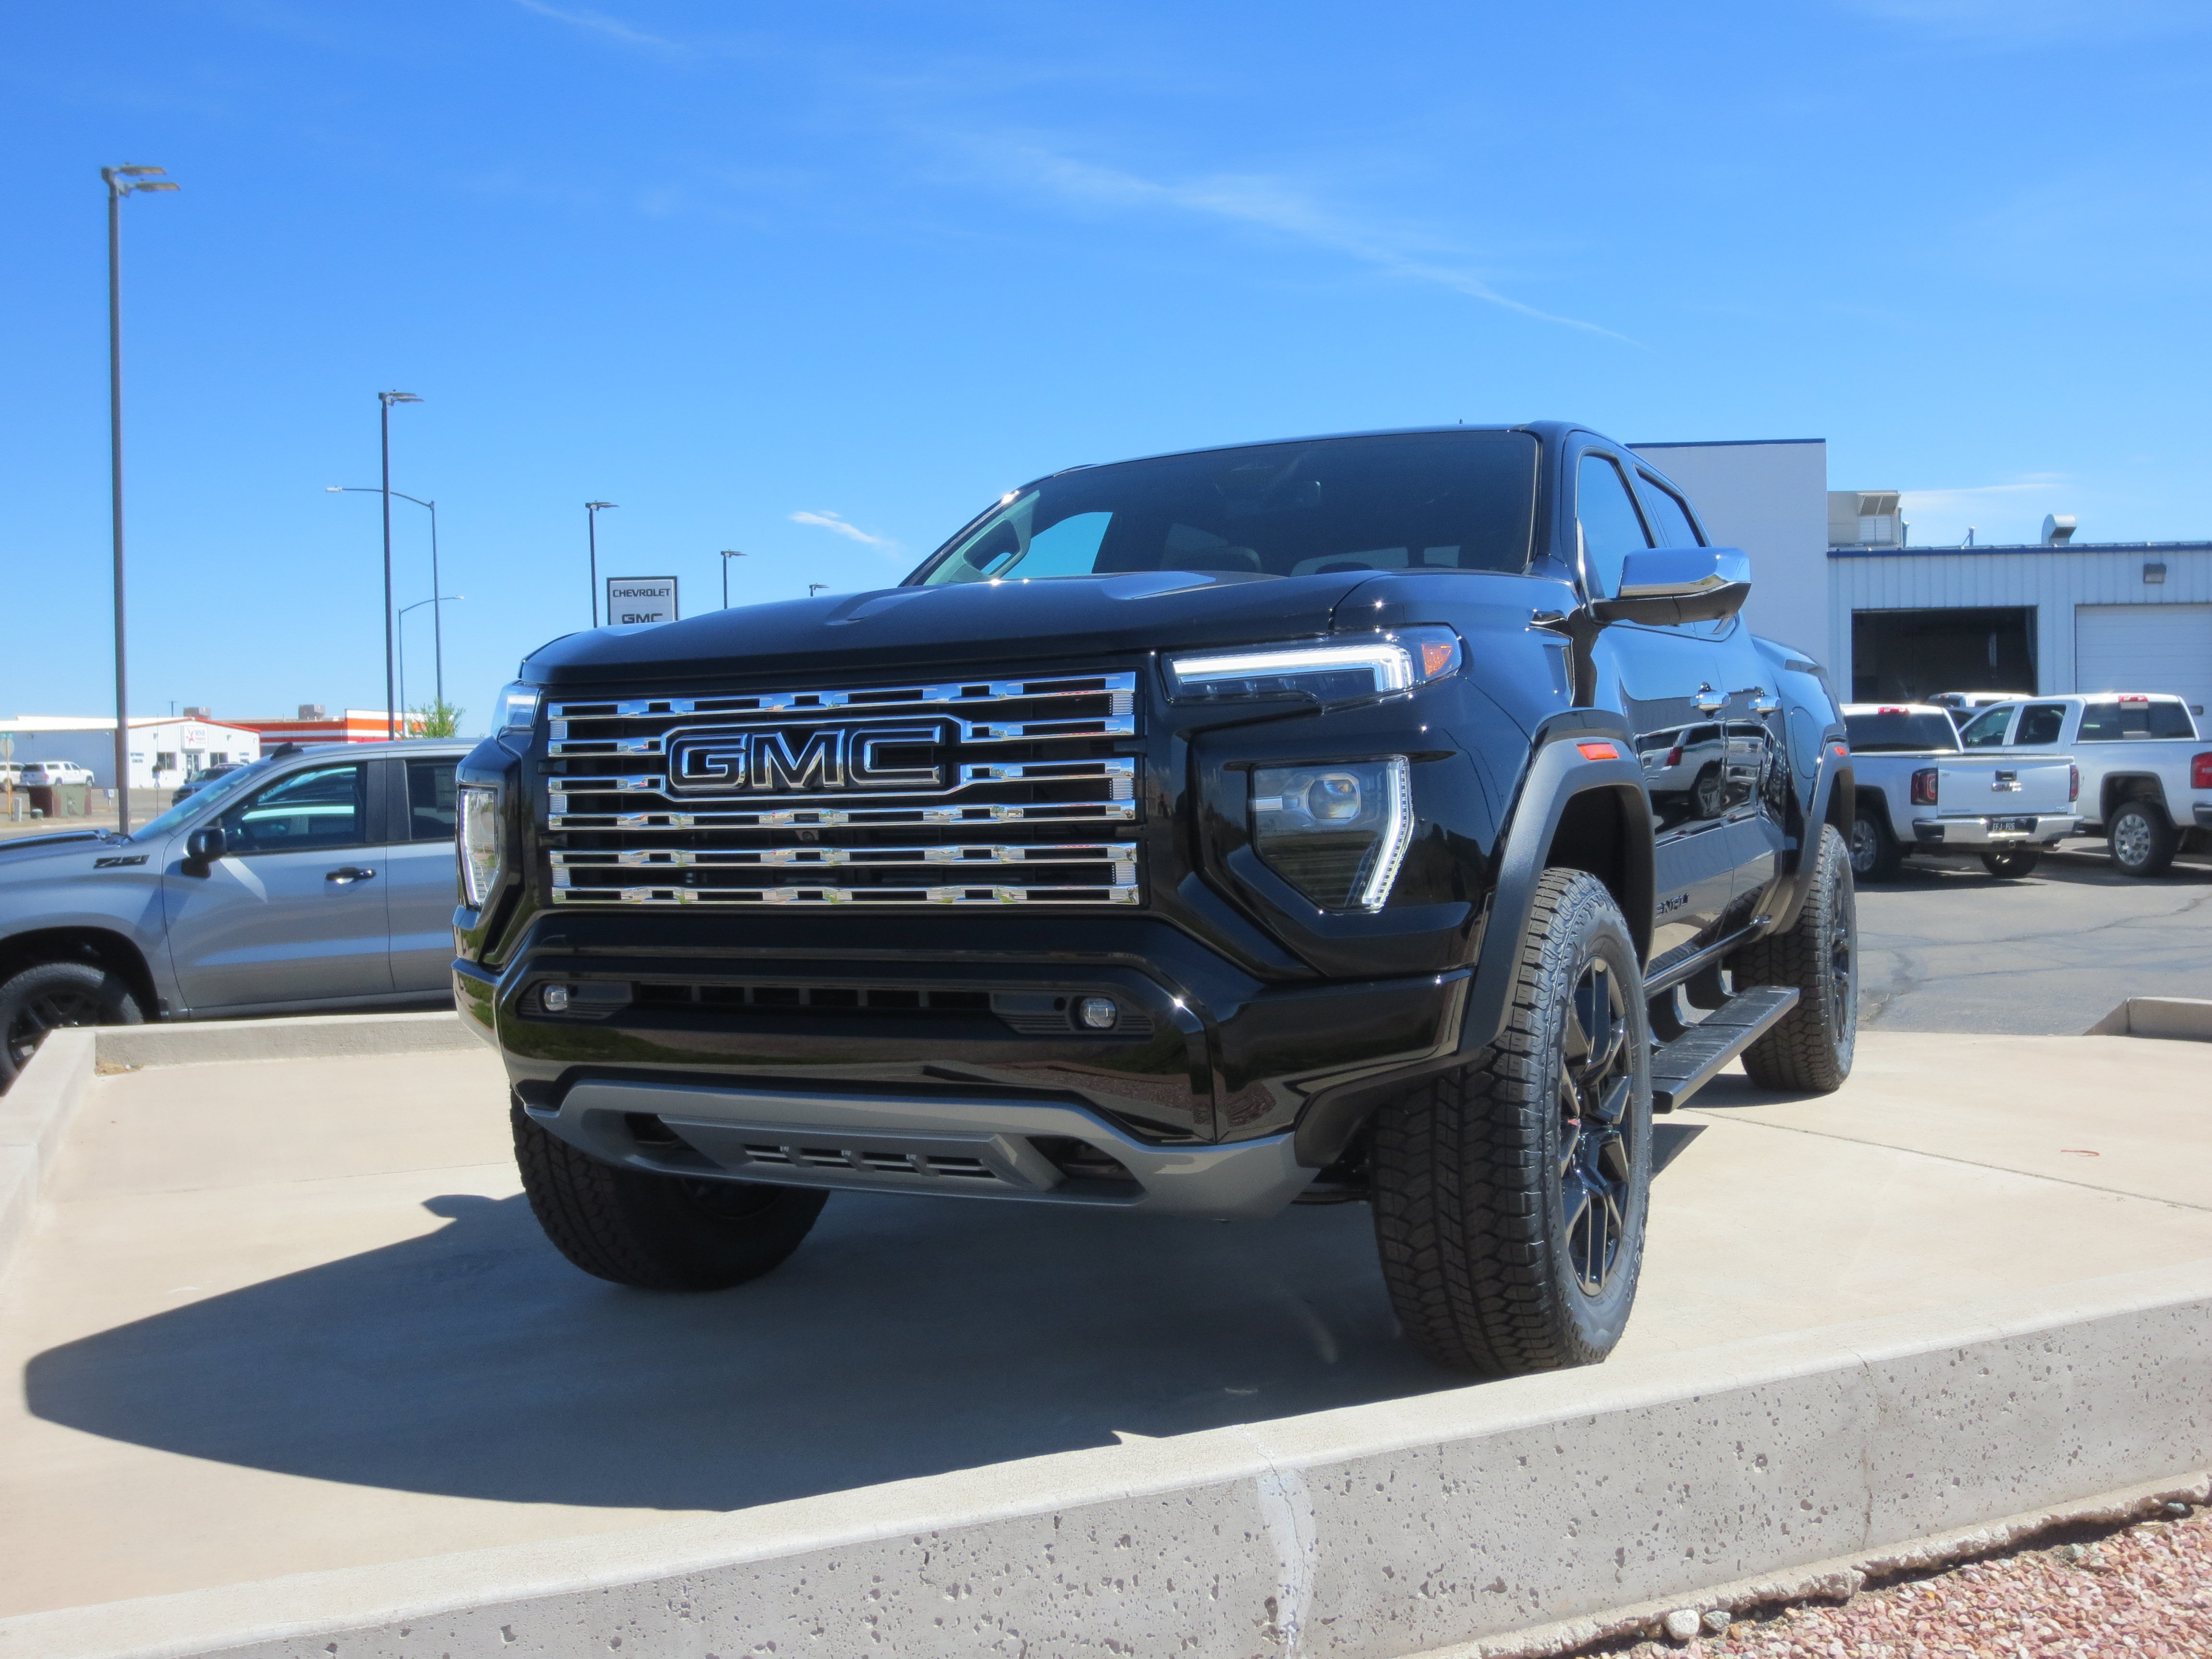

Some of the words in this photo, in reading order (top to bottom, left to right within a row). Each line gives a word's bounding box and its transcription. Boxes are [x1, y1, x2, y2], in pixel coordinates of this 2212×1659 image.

[613, 589, 670, 597] CHEVROLET
[622, 613, 662, 624] GMC
[668, 725, 945, 791] GMC
